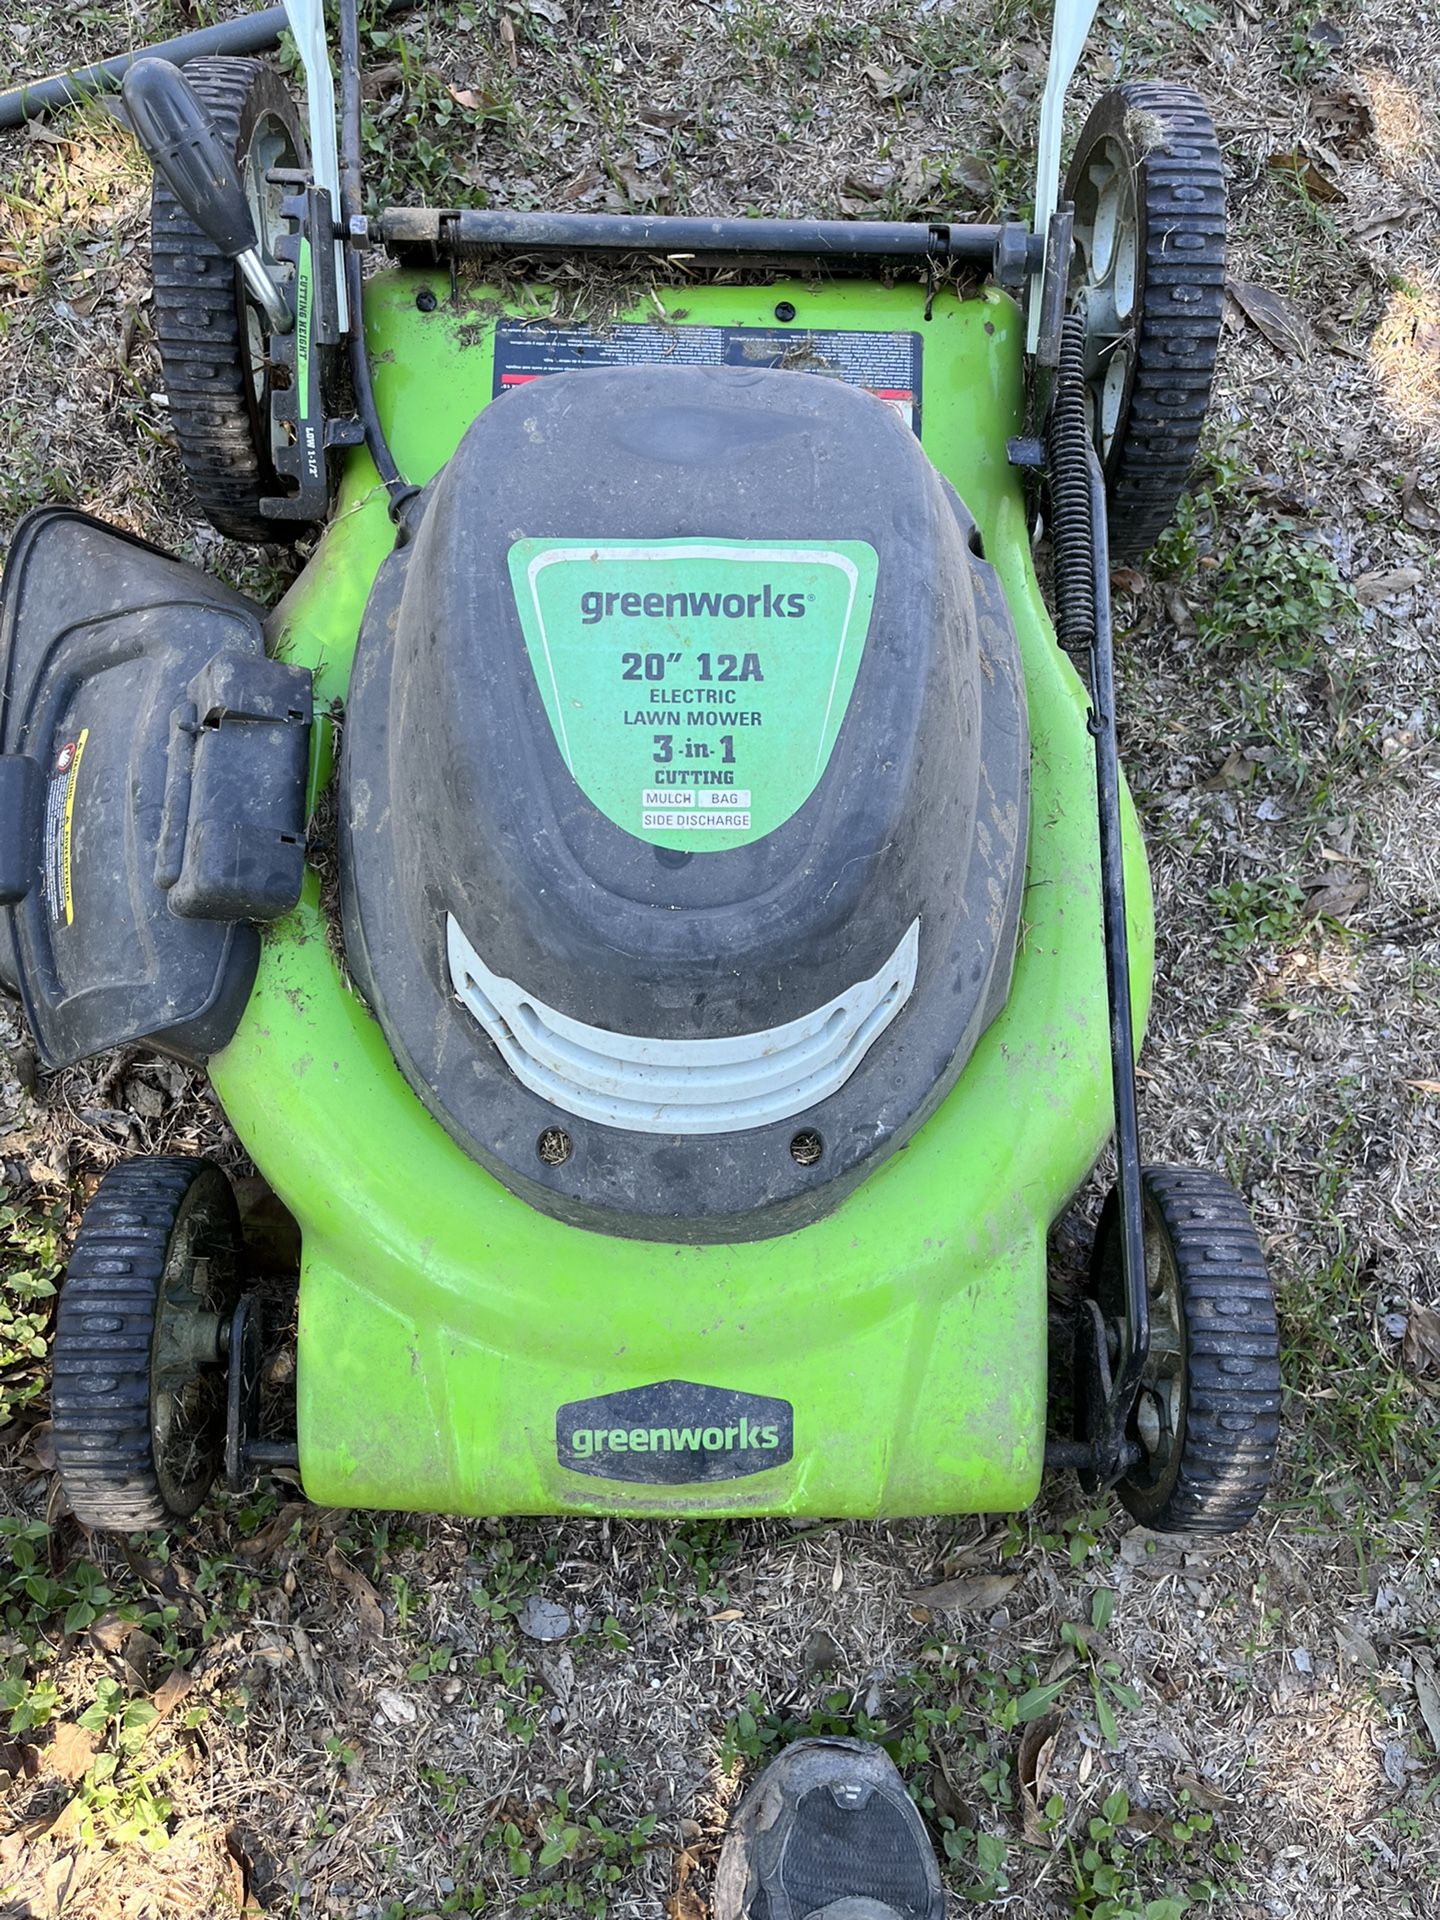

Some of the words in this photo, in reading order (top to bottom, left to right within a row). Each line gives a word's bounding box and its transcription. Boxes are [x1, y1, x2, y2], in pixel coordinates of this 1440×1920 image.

[299, 275, 308, 319] CUTTING
[298, 321, 308, 360] HEIGHT
[305, 427, 315, 449] LOW
[697, 653, 764, 682] 12A
[650, 689, 737, 704] ELECTRIC
[624, 711, 680, 726] LAWN
[687, 711, 762, 726] MOWER
[69, 753, 80, 800] WARNING
[655, 770, 734, 785] CUTTING
[646, 793, 692, 805] MULCH
[711, 793, 738, 805] BAG
[644, 815, 673, 826] SIDE
[677, 815, 750, 826] DISCHARGE
[572, 1417, 779, 1459] greenworks
